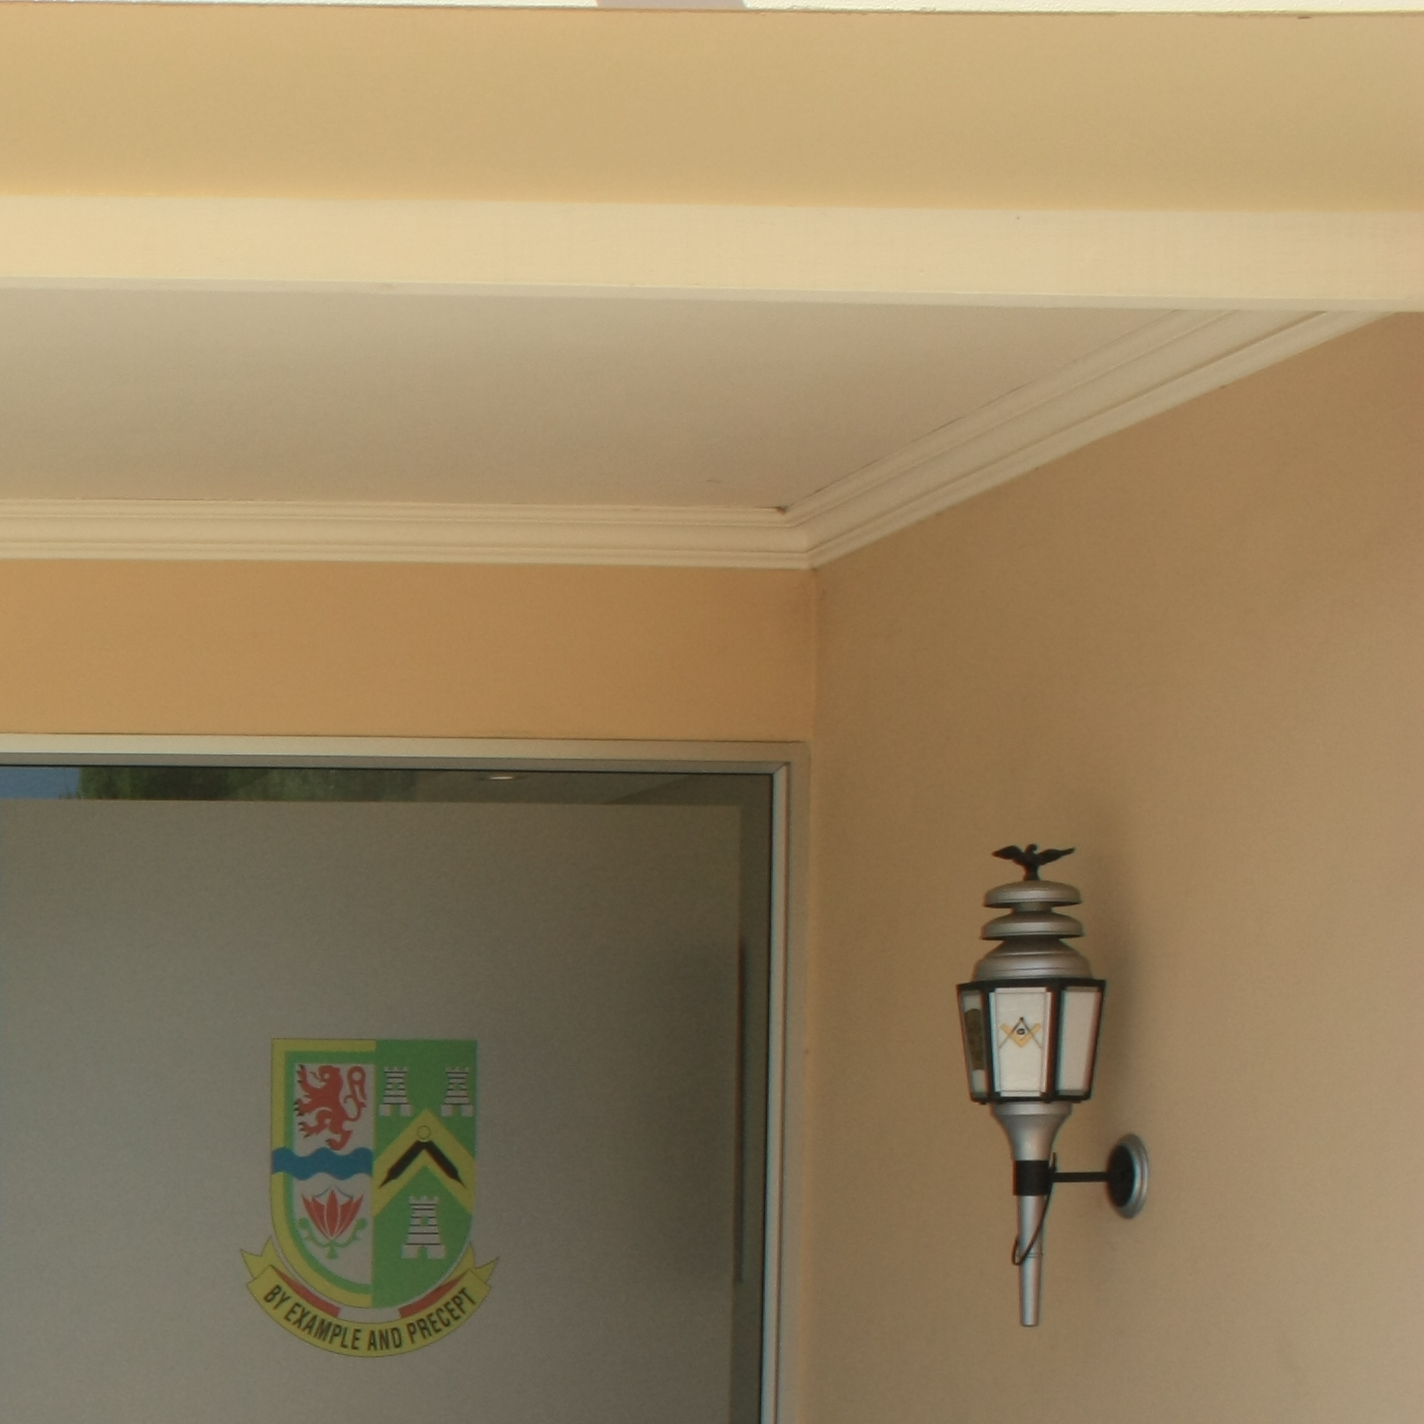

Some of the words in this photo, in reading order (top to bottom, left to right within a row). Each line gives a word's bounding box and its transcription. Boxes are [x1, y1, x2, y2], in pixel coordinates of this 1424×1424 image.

[263, 1284, 291, 1310] BY
[283, 1302, 361, 1351] EXAMPLE
[367, 1326, 403, 1351] AND
[406, 1287, 476, 1344] PRECEPT
